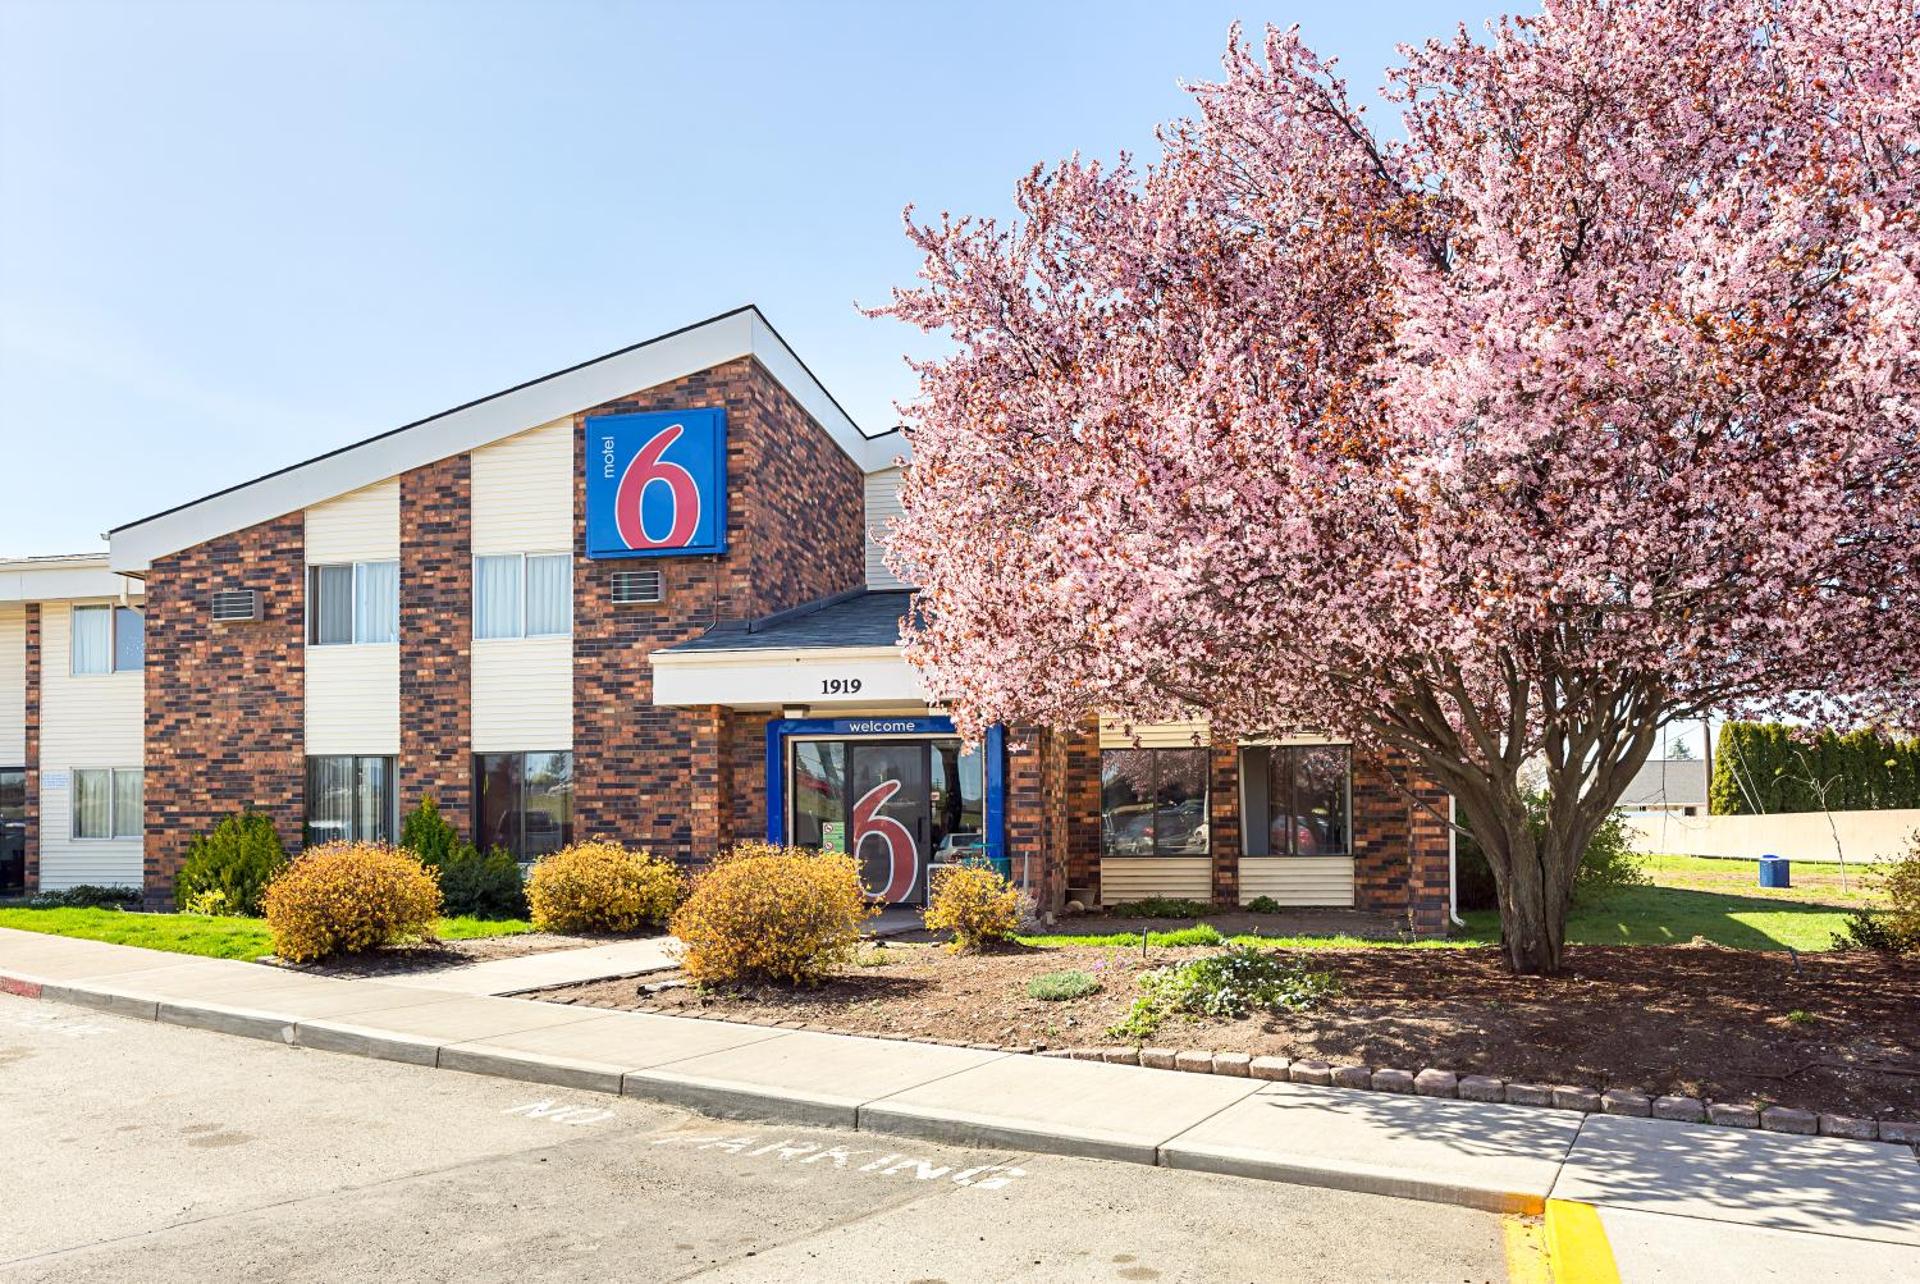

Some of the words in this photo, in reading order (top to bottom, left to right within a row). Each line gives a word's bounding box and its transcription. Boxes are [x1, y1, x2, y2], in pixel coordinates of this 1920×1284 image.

[601, 436, 615, 478] motel
[615, 424, 700, 549] 6
[821, 678, 862, 694] 1919
[849, 720, 915, 732] welcome
[853, 779, 918, 902] 6
[500, 1099, 616, 1124] NO
